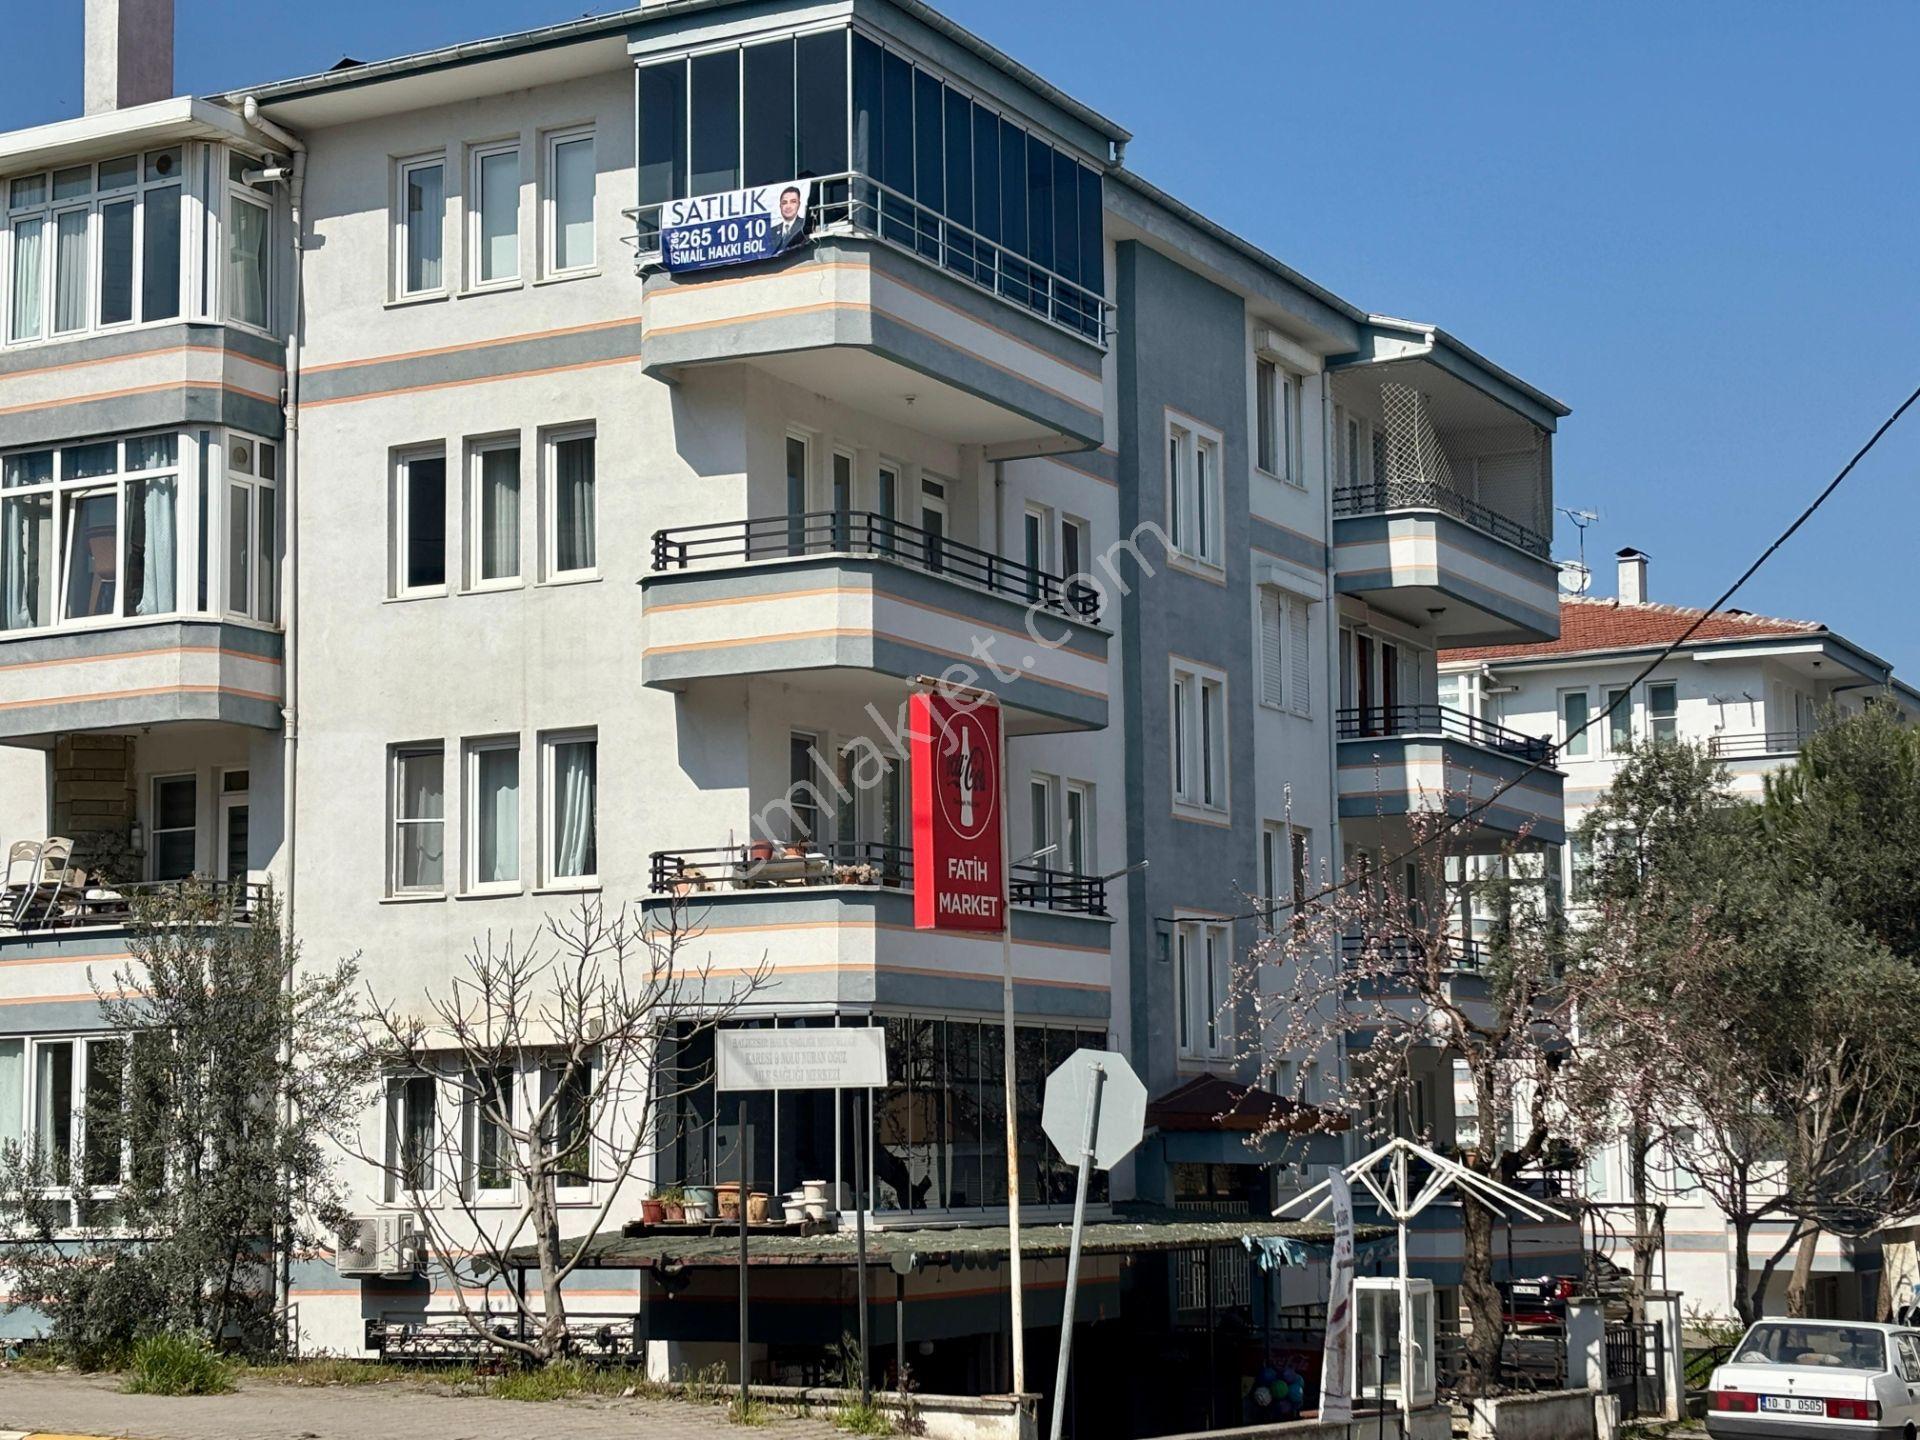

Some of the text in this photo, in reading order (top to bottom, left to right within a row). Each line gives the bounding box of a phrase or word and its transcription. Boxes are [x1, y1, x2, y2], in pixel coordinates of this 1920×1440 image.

[672, 188, 768, 226] SATILIK
[679, 219, 767, 249] 265 10 10
[708, 242, 741, 260] HAKKI
[744, 239, 767, 255] BOL
[948, 856, 988, 882] FATİH
[939, 893, 998, 917] MARKET
[1767, 1397, 1778, 1408] 10
[1798, 1400, 1822, 1411] 0505
